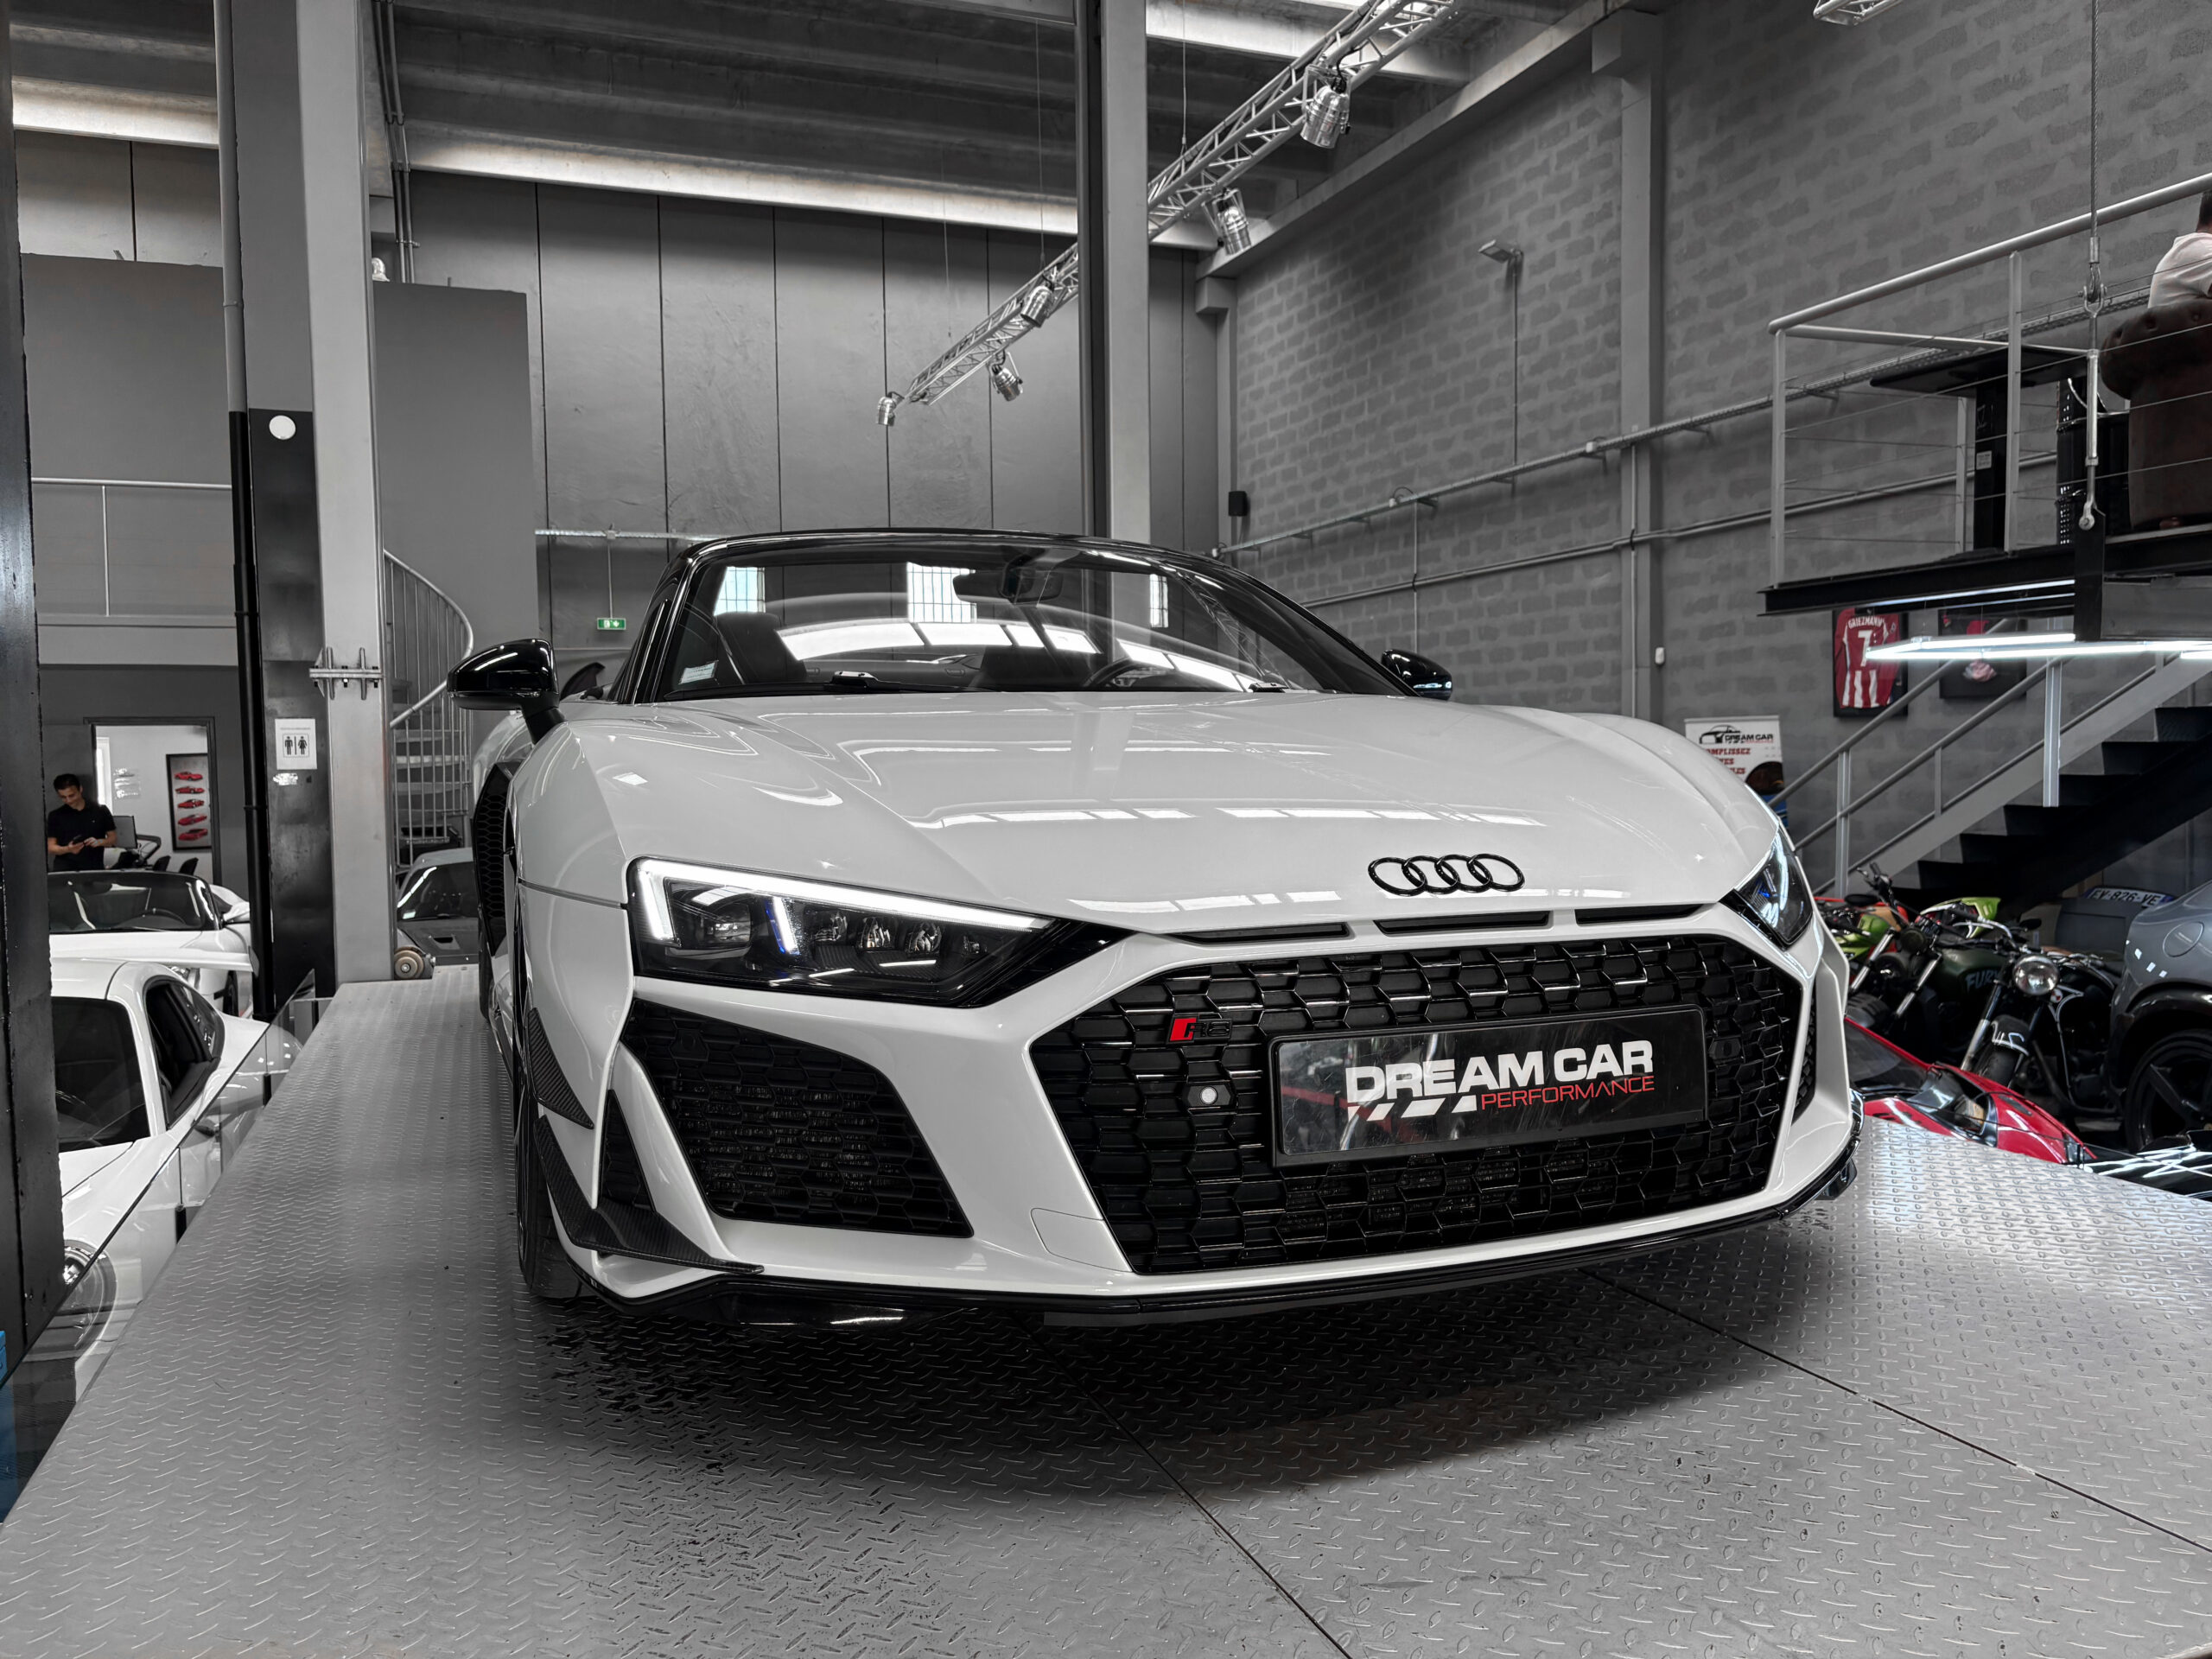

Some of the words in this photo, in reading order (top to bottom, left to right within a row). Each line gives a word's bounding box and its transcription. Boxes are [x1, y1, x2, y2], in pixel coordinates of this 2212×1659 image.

[1858, 629, 1873, 667] 7
[1345, 1050, 1544, 1103] DREAM
[1554, 1039, 1654, 1082] CAR
[1481, 1075, 1655, 1111] PERFORMANCE
